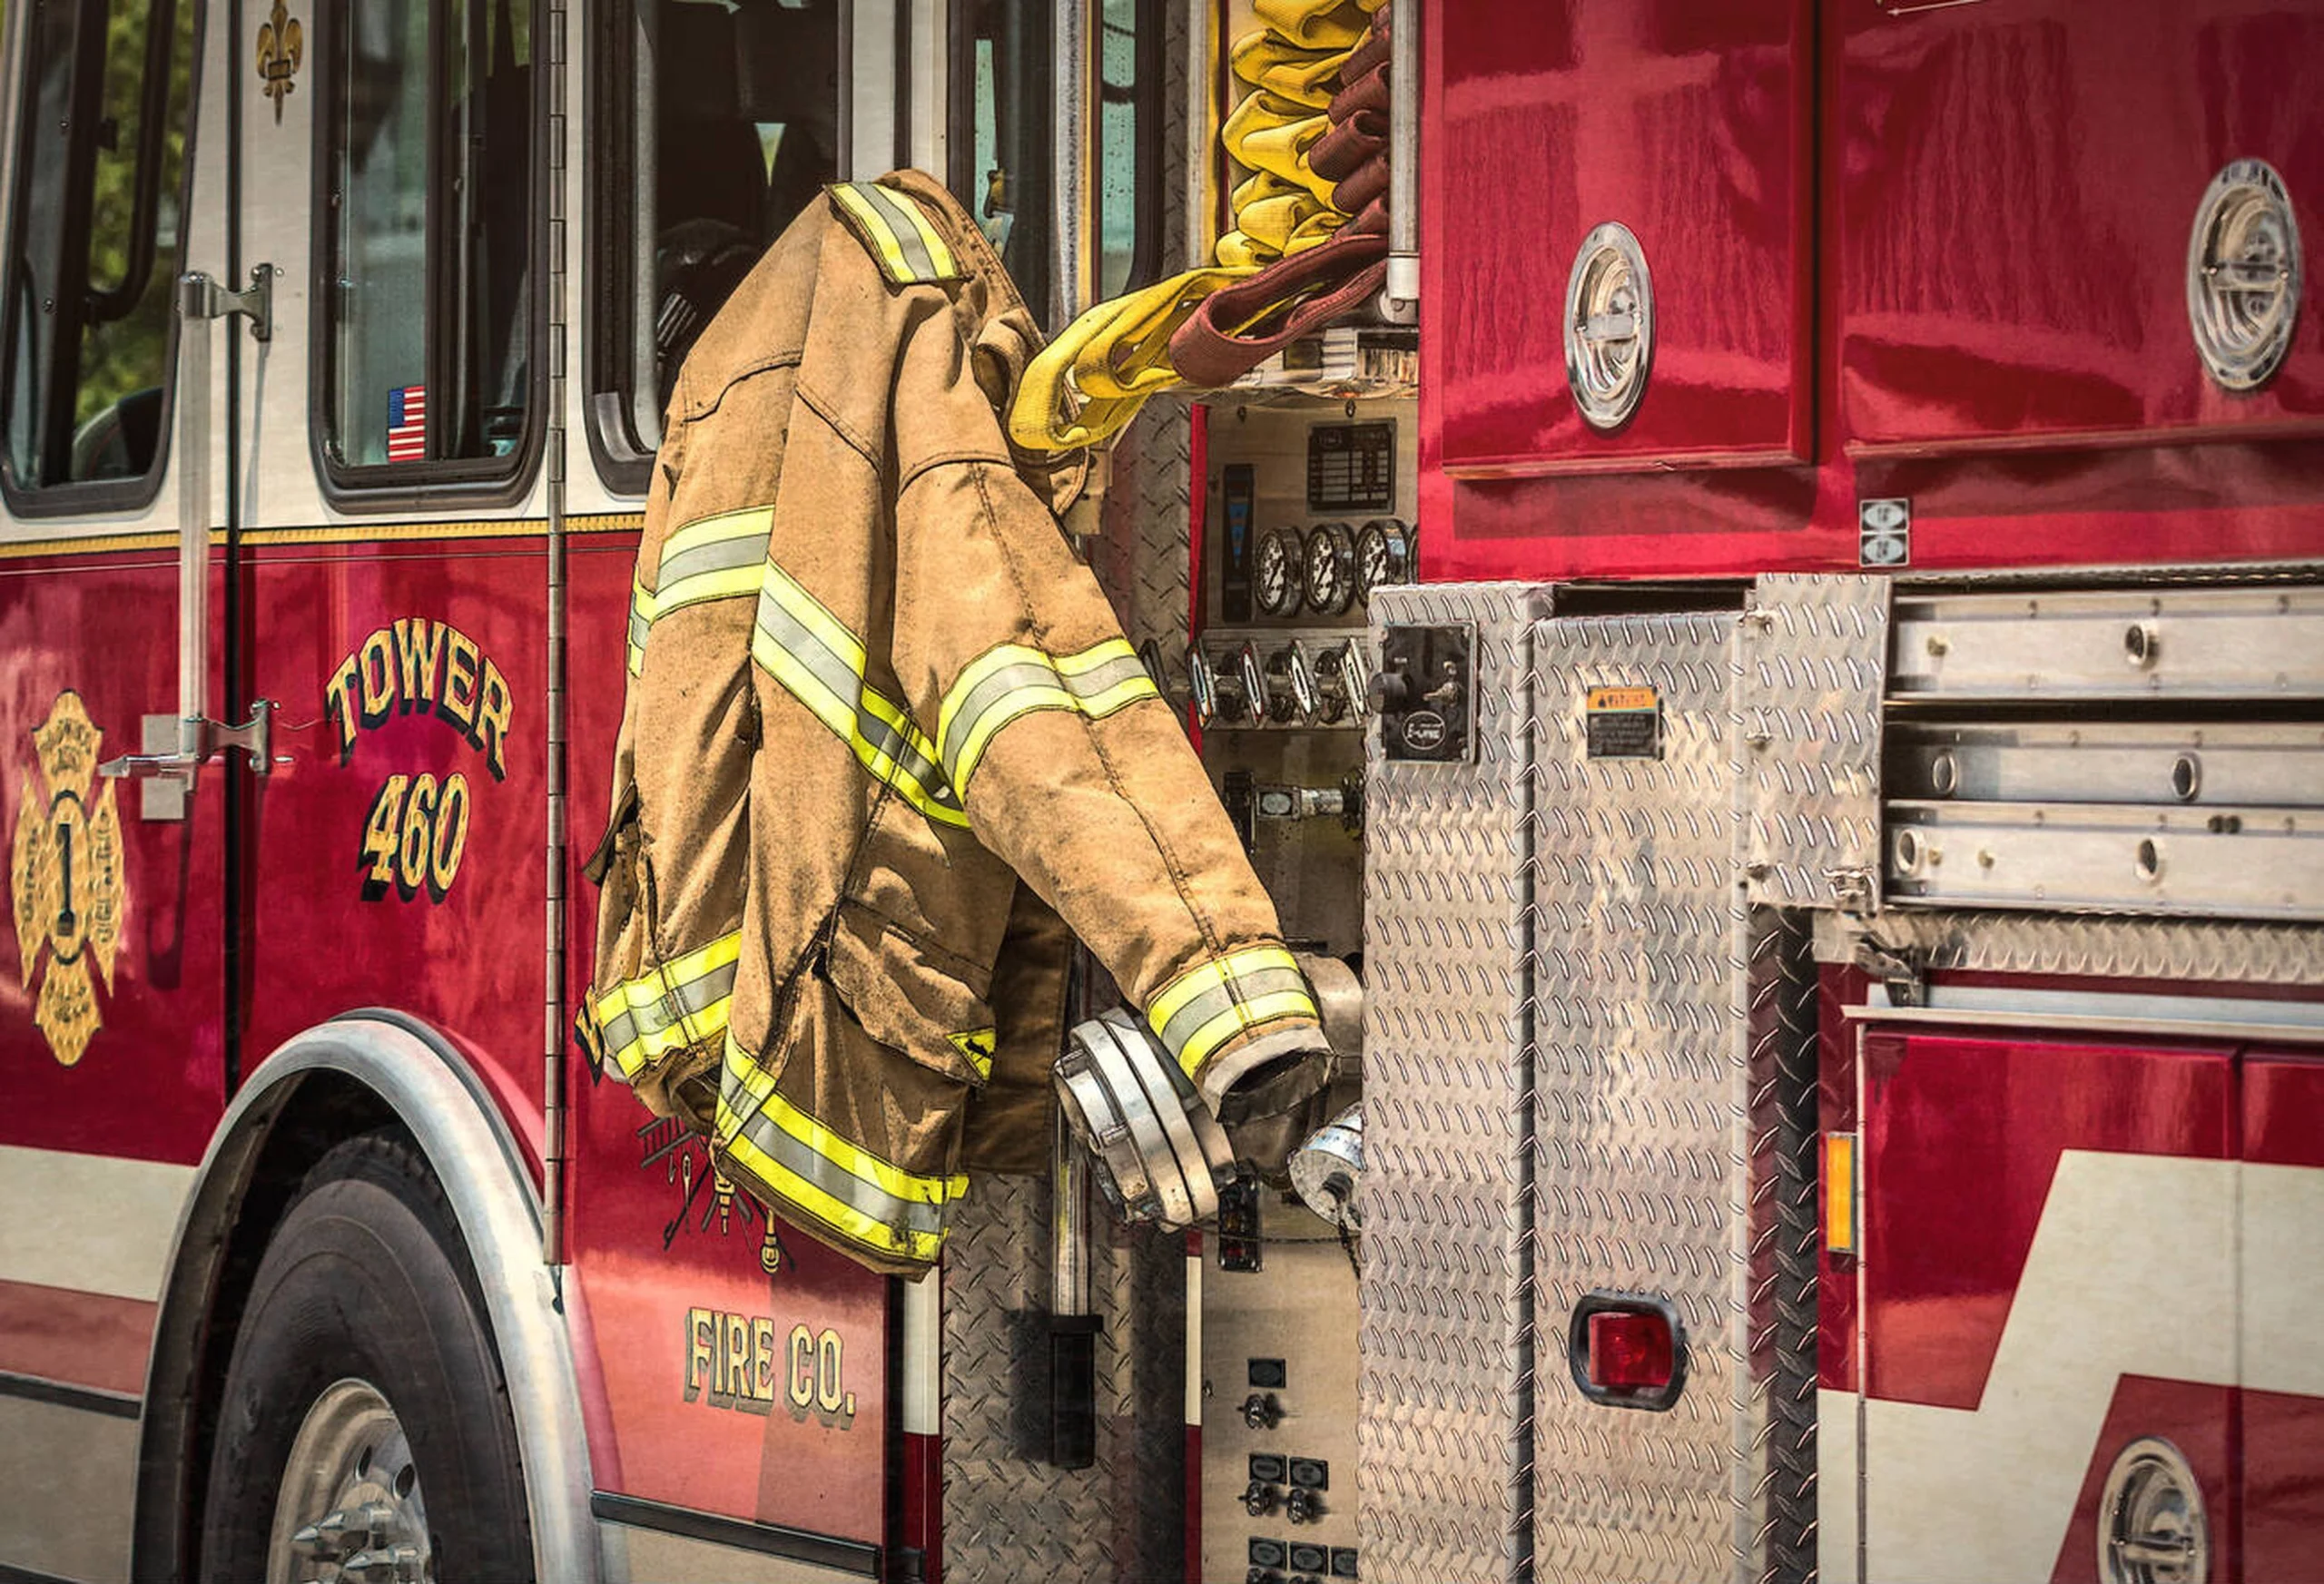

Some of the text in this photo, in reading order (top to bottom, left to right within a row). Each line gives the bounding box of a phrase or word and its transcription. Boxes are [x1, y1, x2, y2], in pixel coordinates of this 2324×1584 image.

[325, 617, 514, 779] TOWER
[359, 772, 470, 897] 460
[686, 1306, 857, 1422] FIRE CO.
